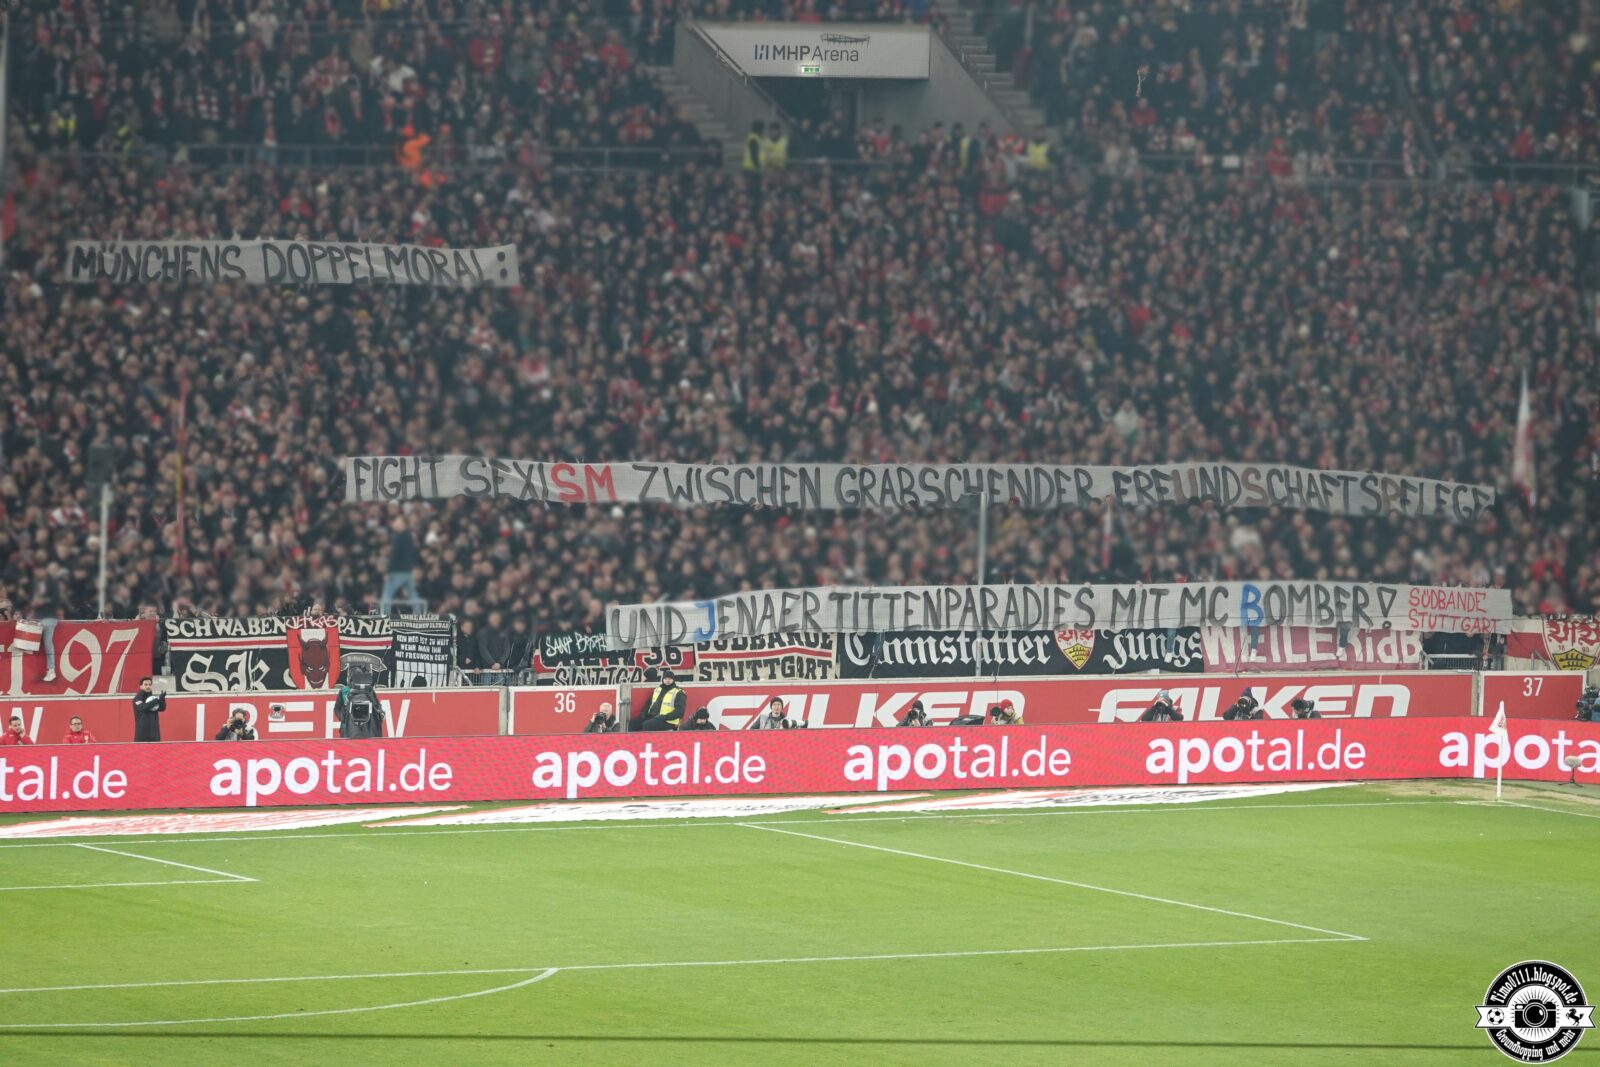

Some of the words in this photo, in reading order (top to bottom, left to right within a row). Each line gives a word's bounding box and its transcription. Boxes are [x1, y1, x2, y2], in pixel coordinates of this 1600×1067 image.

[72, 242, 247, 282] MÜNCHENS
[354, 457, 443, 500] FIGHT
[459, 456, 617, 503] SEXISM
[632, 464, 821, 508] ZWISCHEN
[835, 467, 1101, 509] GRABSCHENDER
[1112, 466, 1491, 522] FREUNDSCHAFTSPFLEGE
[611, 606, 687, 647] UND
[694, 591, 823, 642] JENAER
[828, 587, 1096, 631] TITTENPARADIES
[1110, 588, 1170, 629] MIT
[1179, 586, 1230, 627] MC
[1408, 608, 1501, 633] STUTTGART
[1409, 587, 1487, 613] SÜDBANDE
[59, 627, 140, 694] 97
[699, 655, 833, 681] STUTTGART
[1522, 677, 1545, 697] 37
[554, 692, 576, 713] 36
[209, 748, 453, 806] apotal.de
[532, 741, 766, 799] apotal.de
[843, 735, 1071, 791] apotal.de
[1145, 728, 1366, 784] apotal.de
